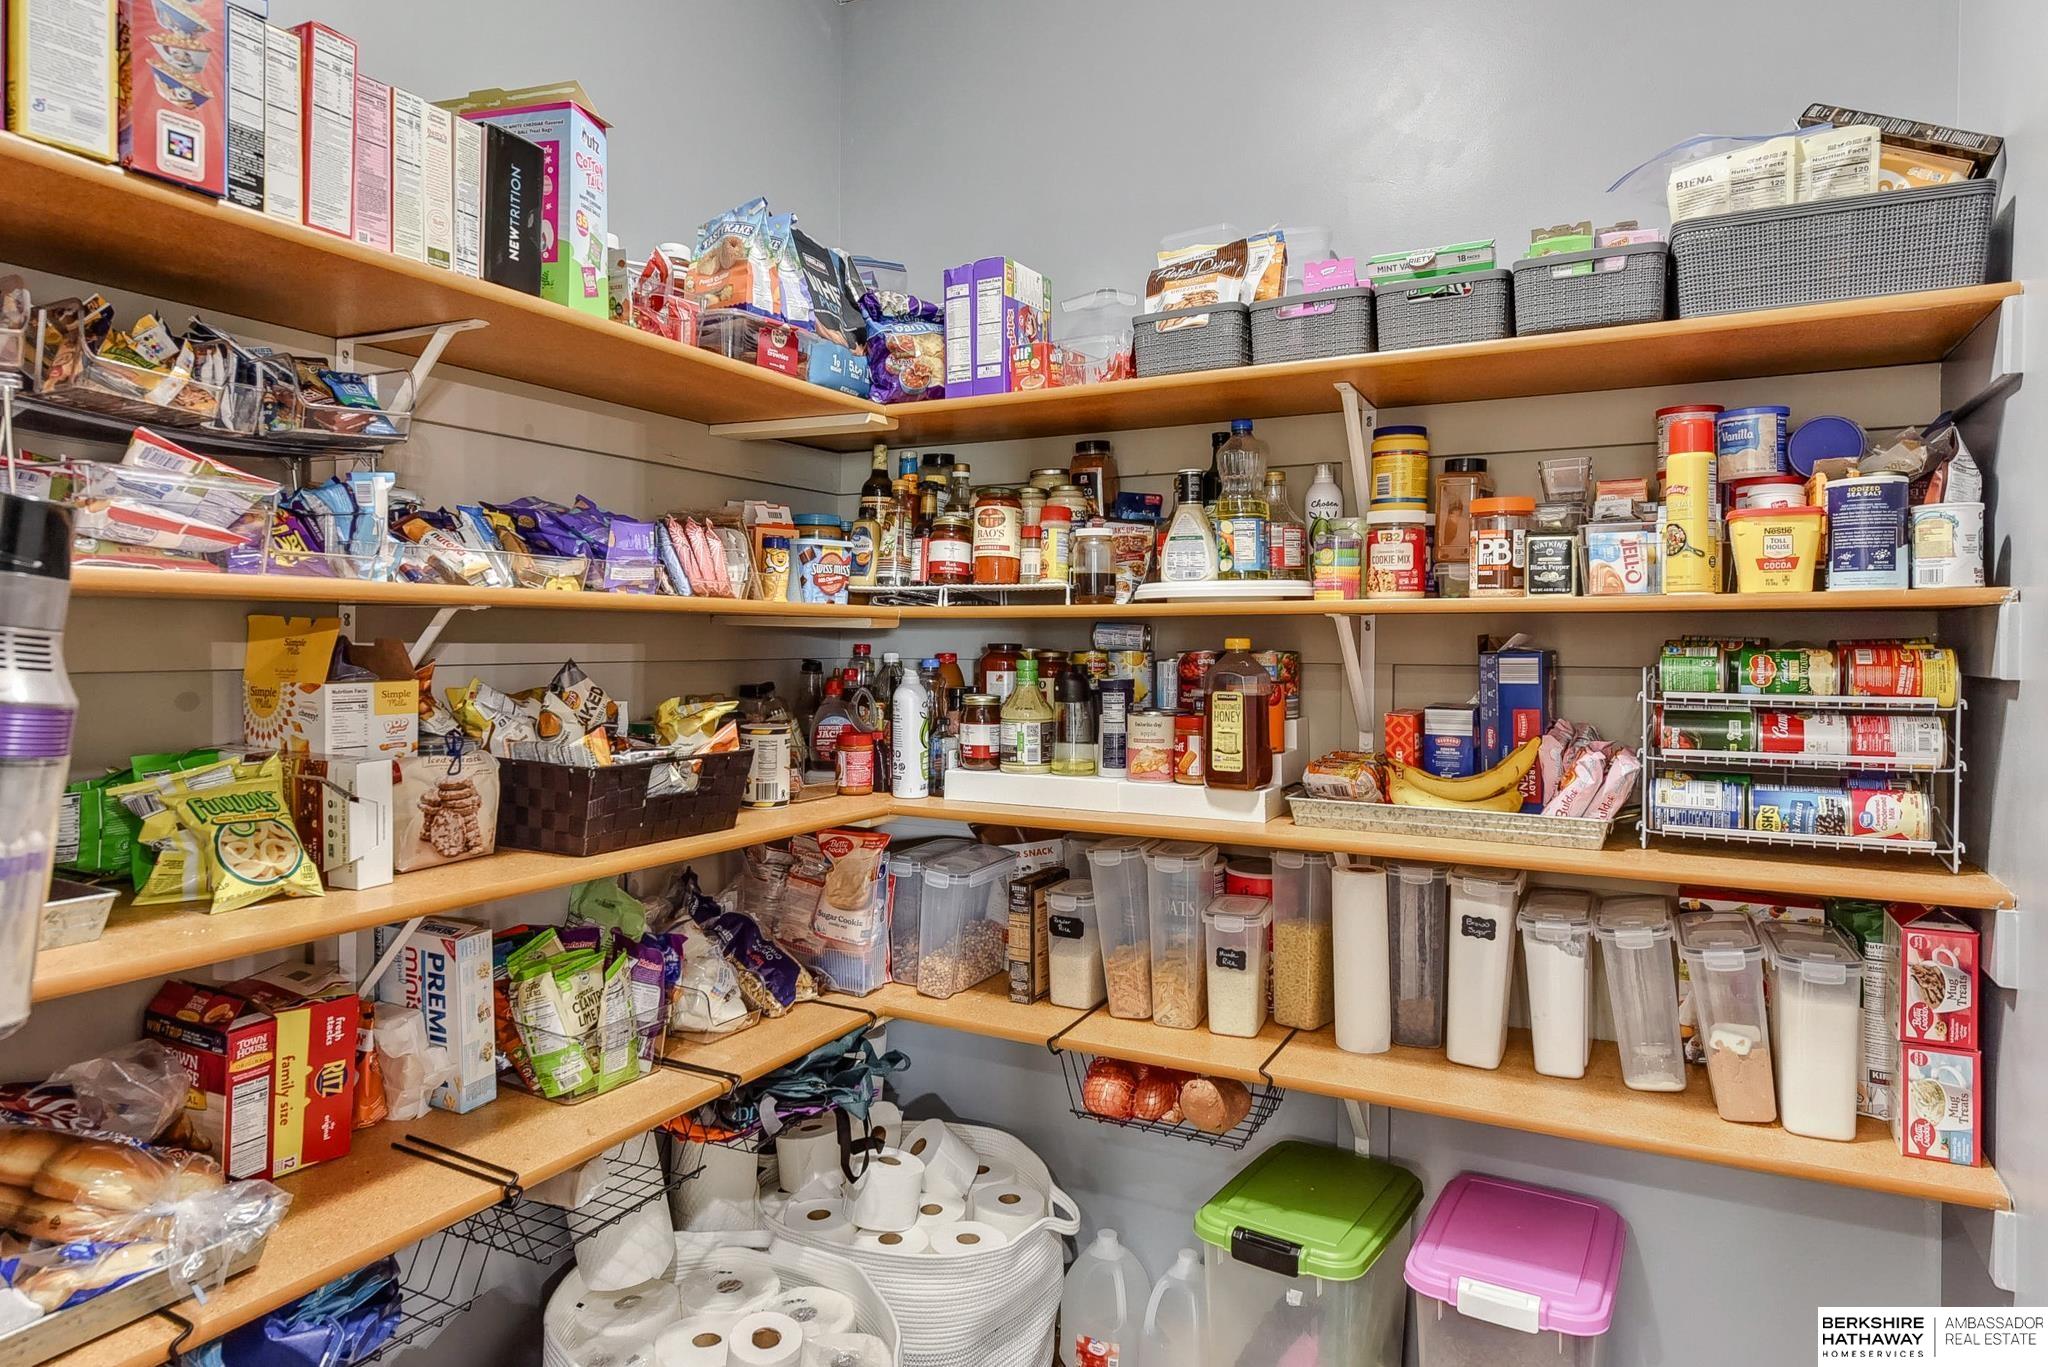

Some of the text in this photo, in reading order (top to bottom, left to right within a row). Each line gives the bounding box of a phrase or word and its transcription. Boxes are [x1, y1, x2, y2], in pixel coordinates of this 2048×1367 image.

[1812, 146, 1869, 163] Nutrition Facts
[1763, 161, 1785, 169] Facts
[1854, 165, 1869, 173] 120
[1676, 175, 1714, 191] BIENA
[1770, 179, 1786, 187] 120
[508, 162, 524, 261] NEWTRITION
[702, 222, 754, 250] TASTYKAKE
[1457, 254, 1467, 263] 18
[1377, 264, 1398, 273] MINT
[1722, 428, 1754, 442] Vanilla
[1848, 485, 1881, 493] IODIZED
[1311, 499, 1339, 509] Chosen
[977, 528, 1005, 539] RAO'S
[1478, 539, 1512, 565] PB
[1532, 541, 1569, 551] WATKINS
[1371, 554, 1411, 565] COOKIE MIX
[812, 562, 850, 577] SWISS MISS
[1548, 564, 1570, 573] Pepper
[283, 637, 307, 648] Simple
[1757, 655, 1765, 685] Del Monte
[250, 685, 277, 698] Simple
[1799, 678, 1808, 692] NEW
[381, 689, 412, 700] Simple
[579, 684, 606, 728] AKED
[1214, 711, 1241, 723] HONEY
[1529, 769, 1537, 796] READY
[186, 791, 281, 825] FUNYUNS
[1556, 787, 1579, 819] Buldak
[1599, 792, 1617, 820] uldak
[1761, 807, 1775, 831] USH'S
[1792, 801, 1804, 827] Beans
[1880, 796, 1888, 831] Condensed
[1887, 807, 1896, 820] Milk
[1023, 846, 1054, 859] SNACK
[817, 909, 863, 927] Sugar Cookie
[1465, 917, 1491, 928] Brown
[405, 946, 419, 1009] minis
[1946, 978, 1958, 1001] Mug
[1956, 974, 1968, 1007] Treats
[578, 1012, 598, 1028] LIME
[325, 1015, 338, 1046] stacks
[333, 1015, 346, 1042] fresh
[237, 1033, 267, 1049] TOWN
[236, 1041, 269, 1059] HOUSE
[321, 1059, 348, 1098] RITZ
[274, 1055, 296, 1126] family size
[1948, 1095, 1960, 1119] Mug
[1958, 1092, 1970, 1125] Treats
[284, 1156, 296, 1170] 12
